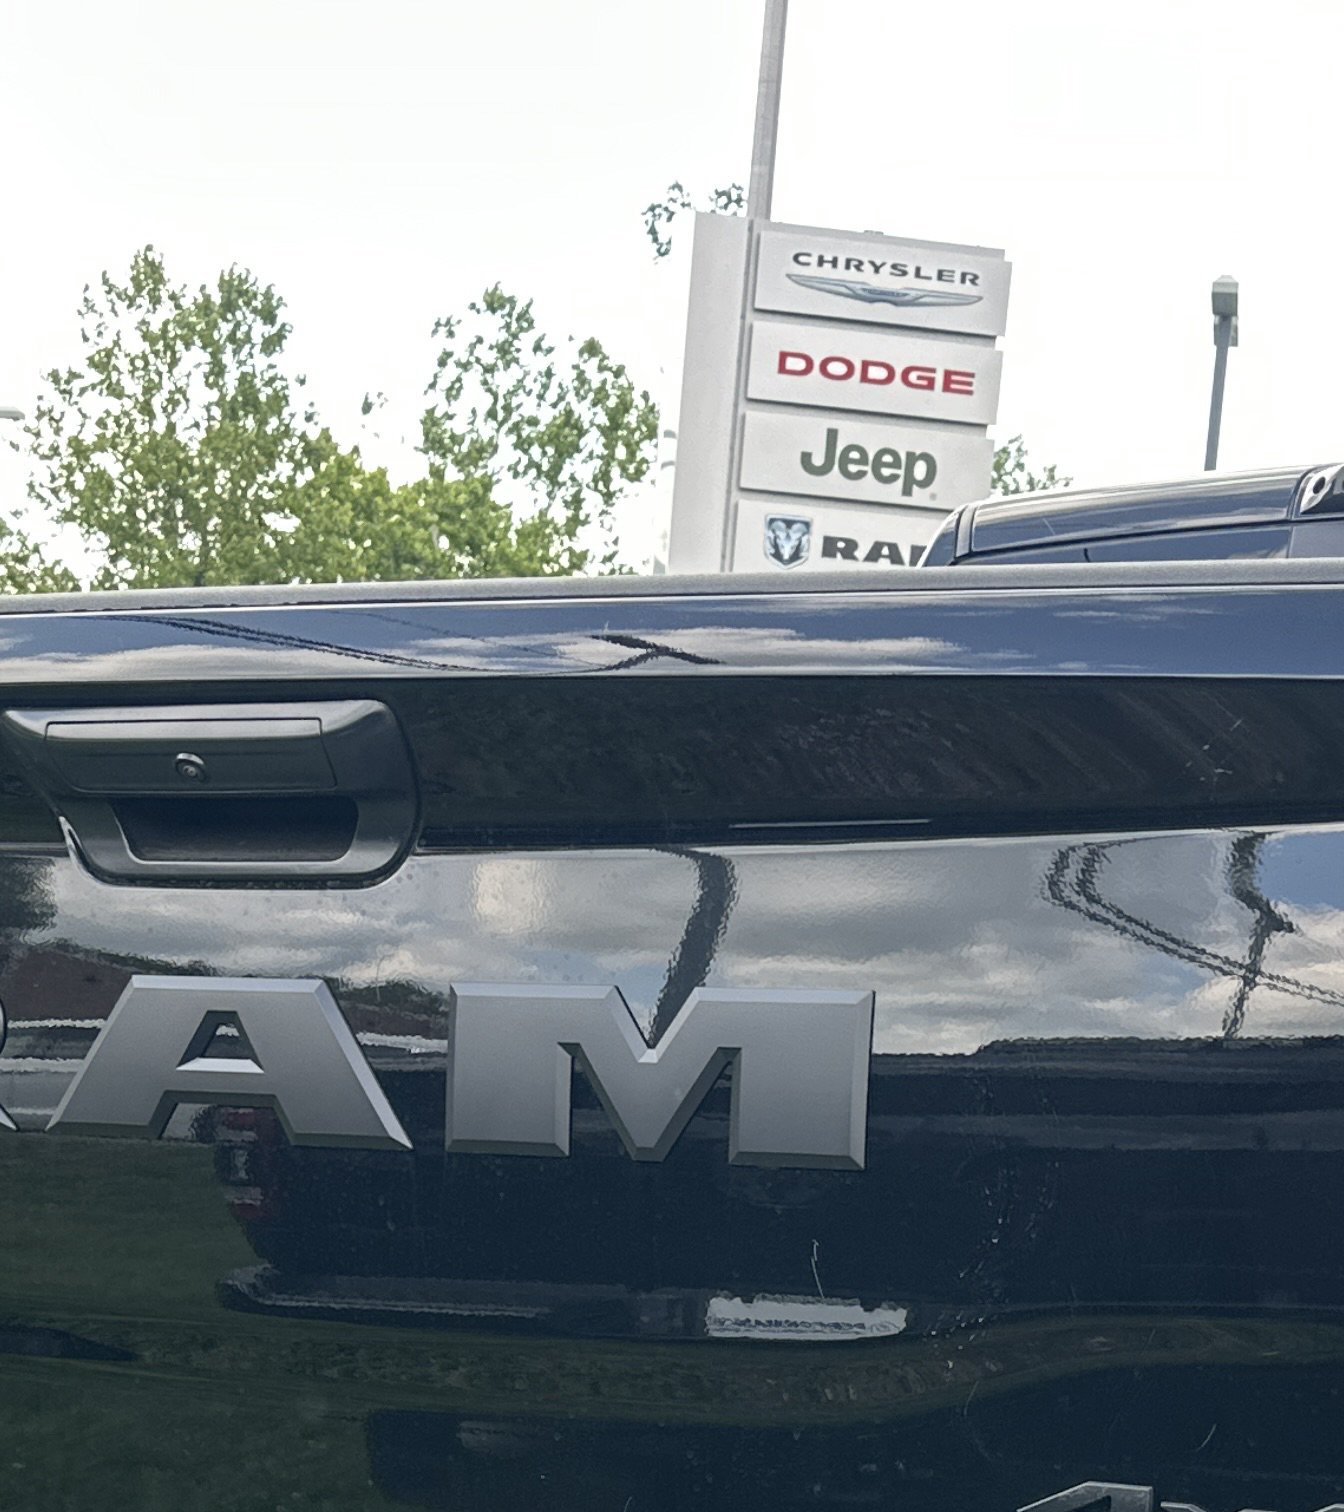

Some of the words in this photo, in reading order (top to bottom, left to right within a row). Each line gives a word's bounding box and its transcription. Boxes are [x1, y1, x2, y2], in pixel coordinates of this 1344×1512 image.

[792, 251, 981, 287] CHRYSLER
[777, 350, 976, 396] DODGE
[800, 427, 938, 497] Jeep
